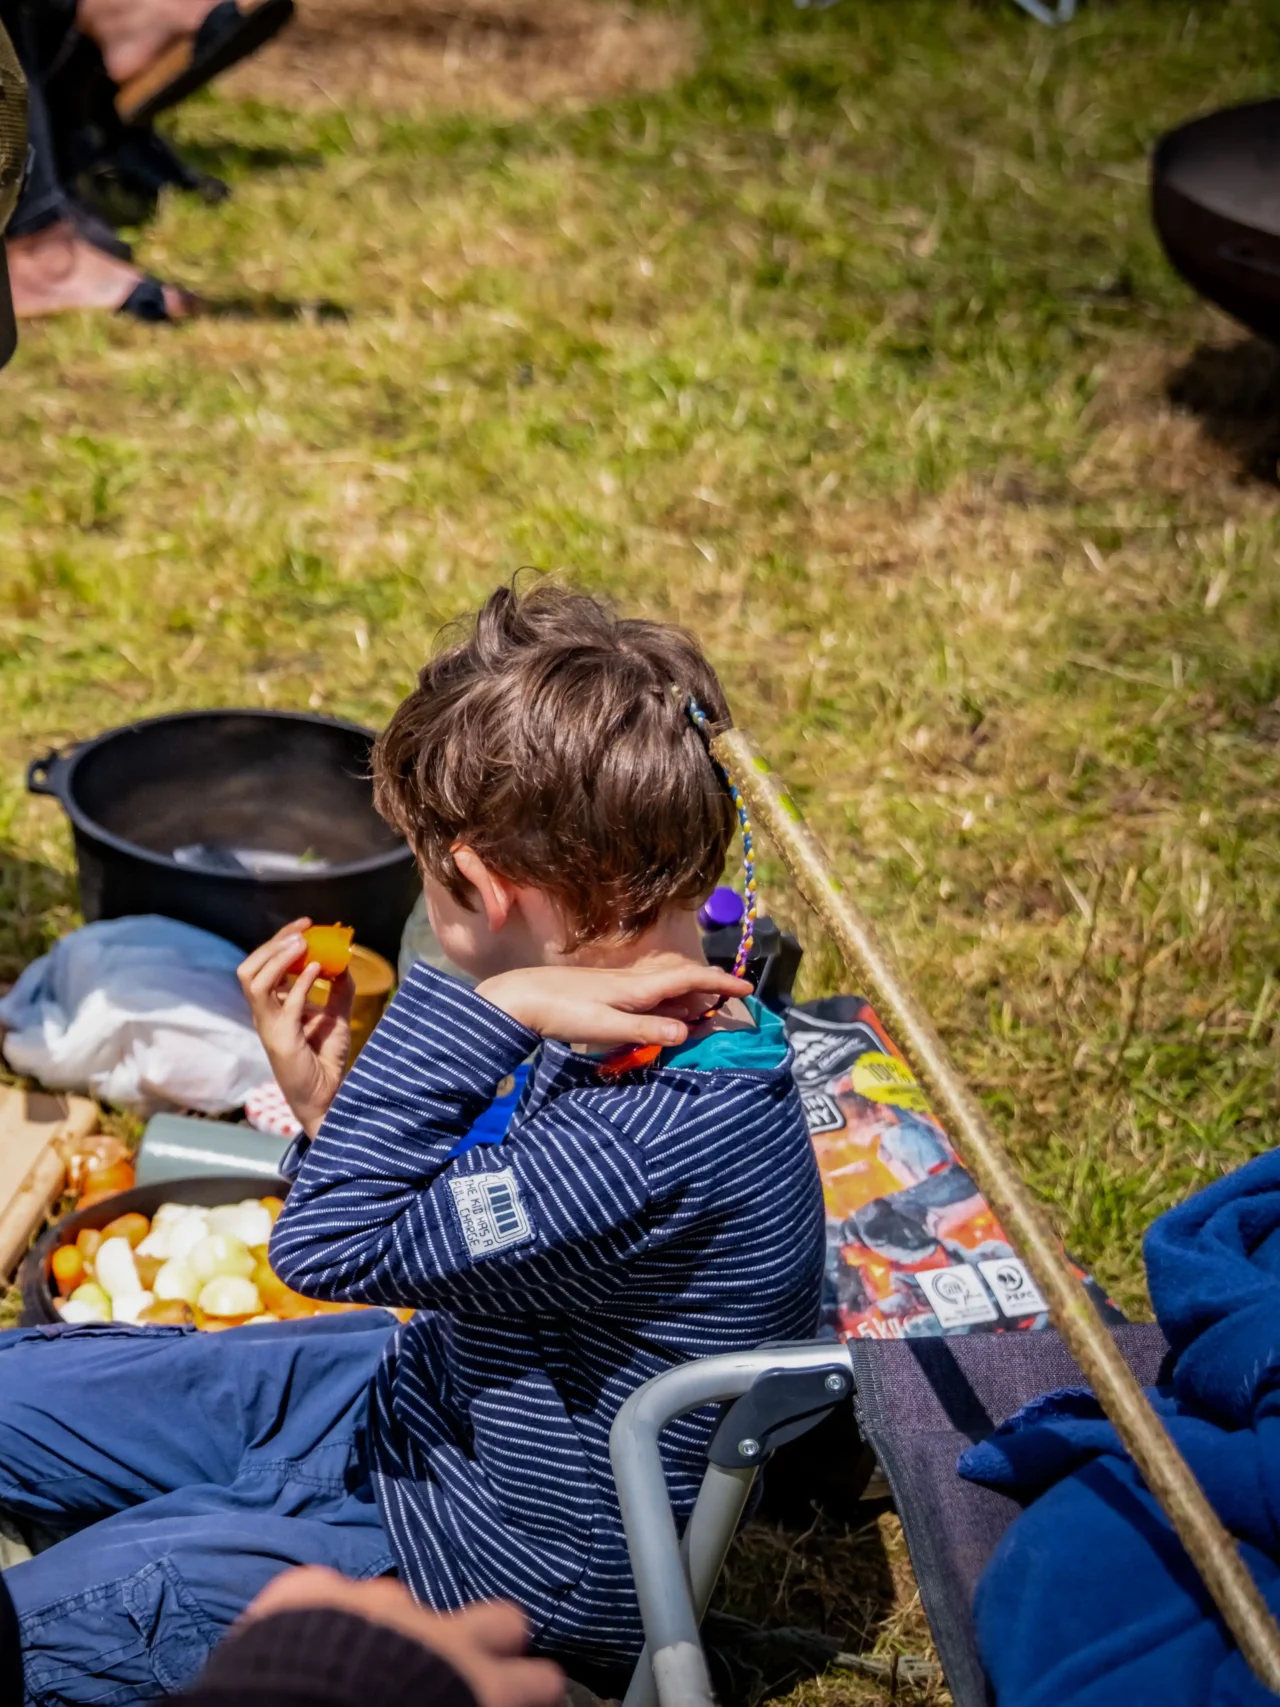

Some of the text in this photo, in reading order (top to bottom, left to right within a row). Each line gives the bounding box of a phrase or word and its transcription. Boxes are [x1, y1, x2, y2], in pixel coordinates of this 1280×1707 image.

[451, 1180, 480, 1247] FULL CHARGE
[464, 1179, 494, 1247] THE KID HAS A
